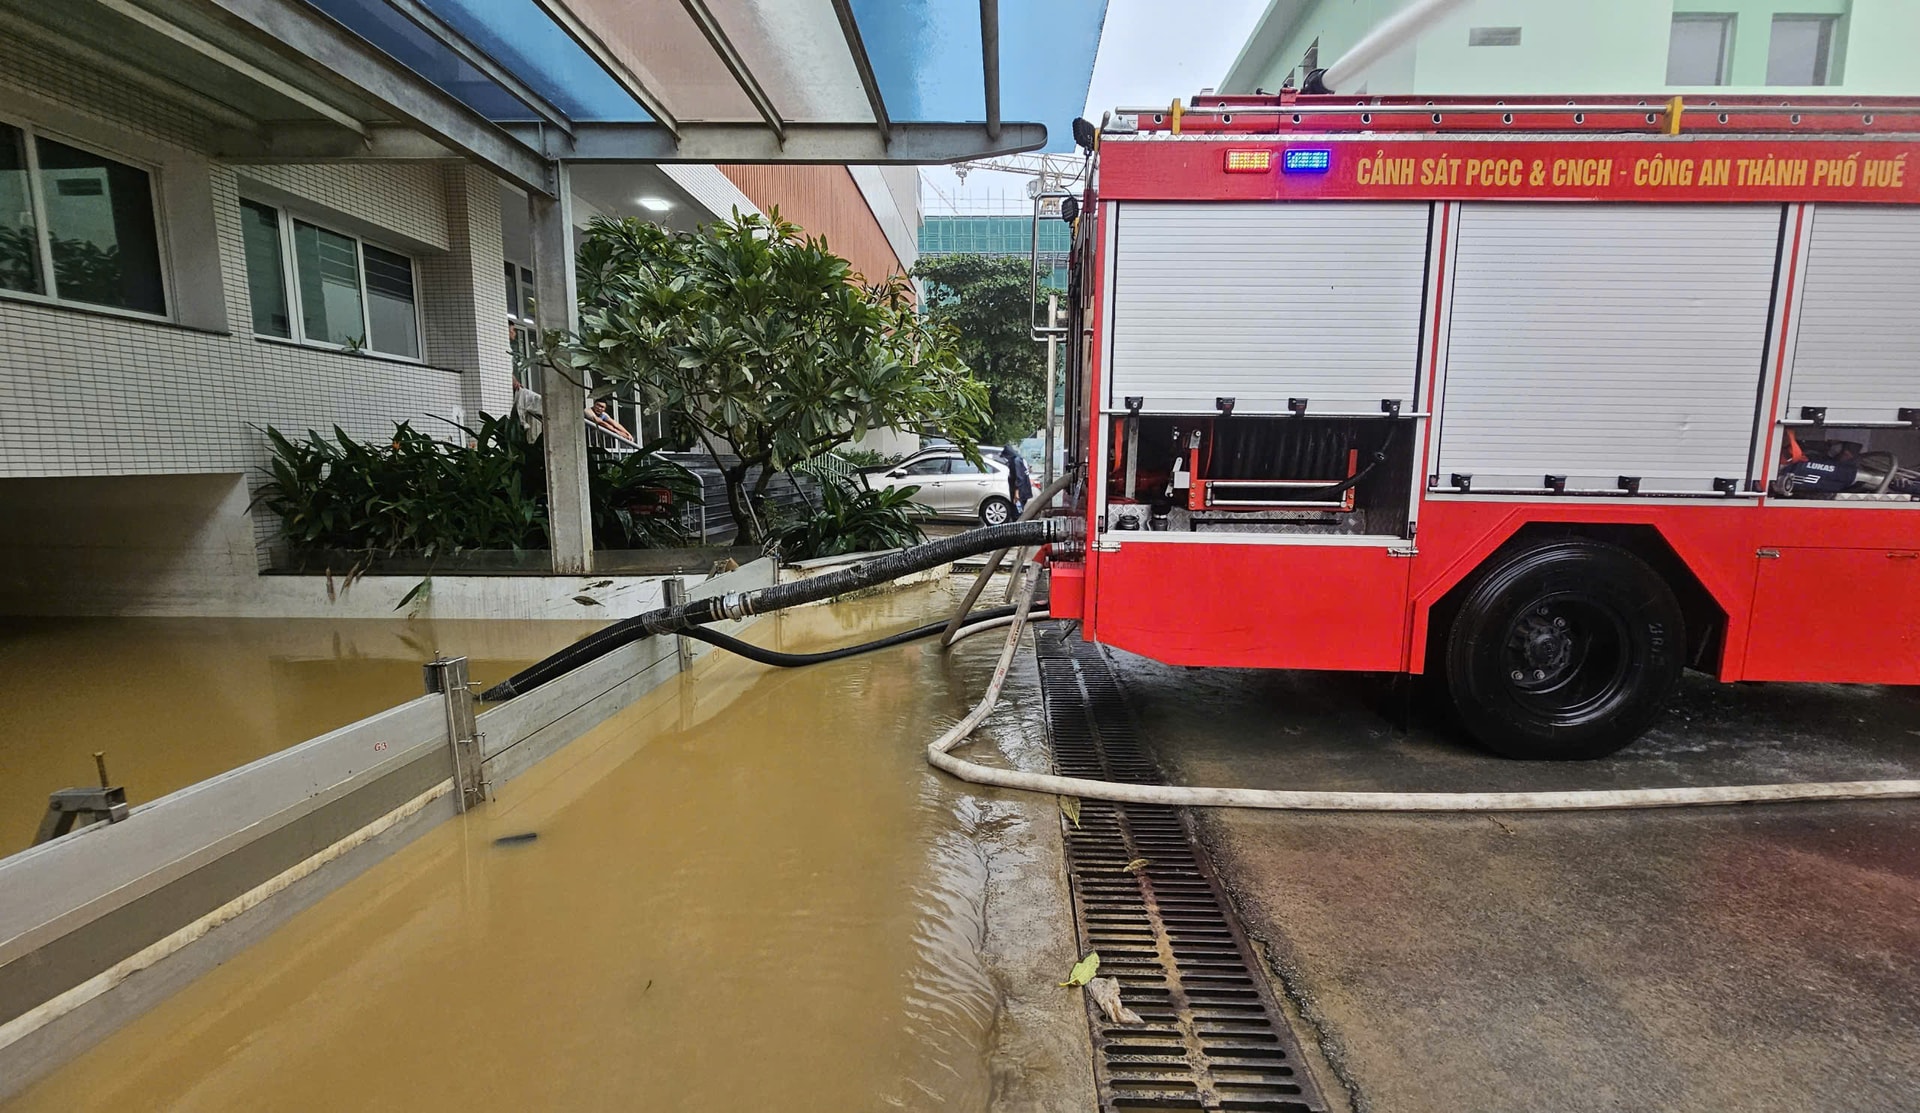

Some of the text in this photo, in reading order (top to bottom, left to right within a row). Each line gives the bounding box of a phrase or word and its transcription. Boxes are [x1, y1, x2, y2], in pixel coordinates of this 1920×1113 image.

[1357, 150, 1415, 185] CẢNH
[1420, 153, 1461, 186] SÁT
[1466, 159, 1523, 186] PCCC
[1529, 159, 1546, 186] &
[1552, 159, 1613, 187] CNCH
[1634, 153, 1694, 187] CÔNG
[1698, 159, 1731, 187] AN
[1737, 153, 1808, 187] THÀNH
[1812, 151, 1862, 187] PHỐ
[1862, 152, 1909, 188] HUẾ
[1806, 461, 1835, 472] LUKAS
